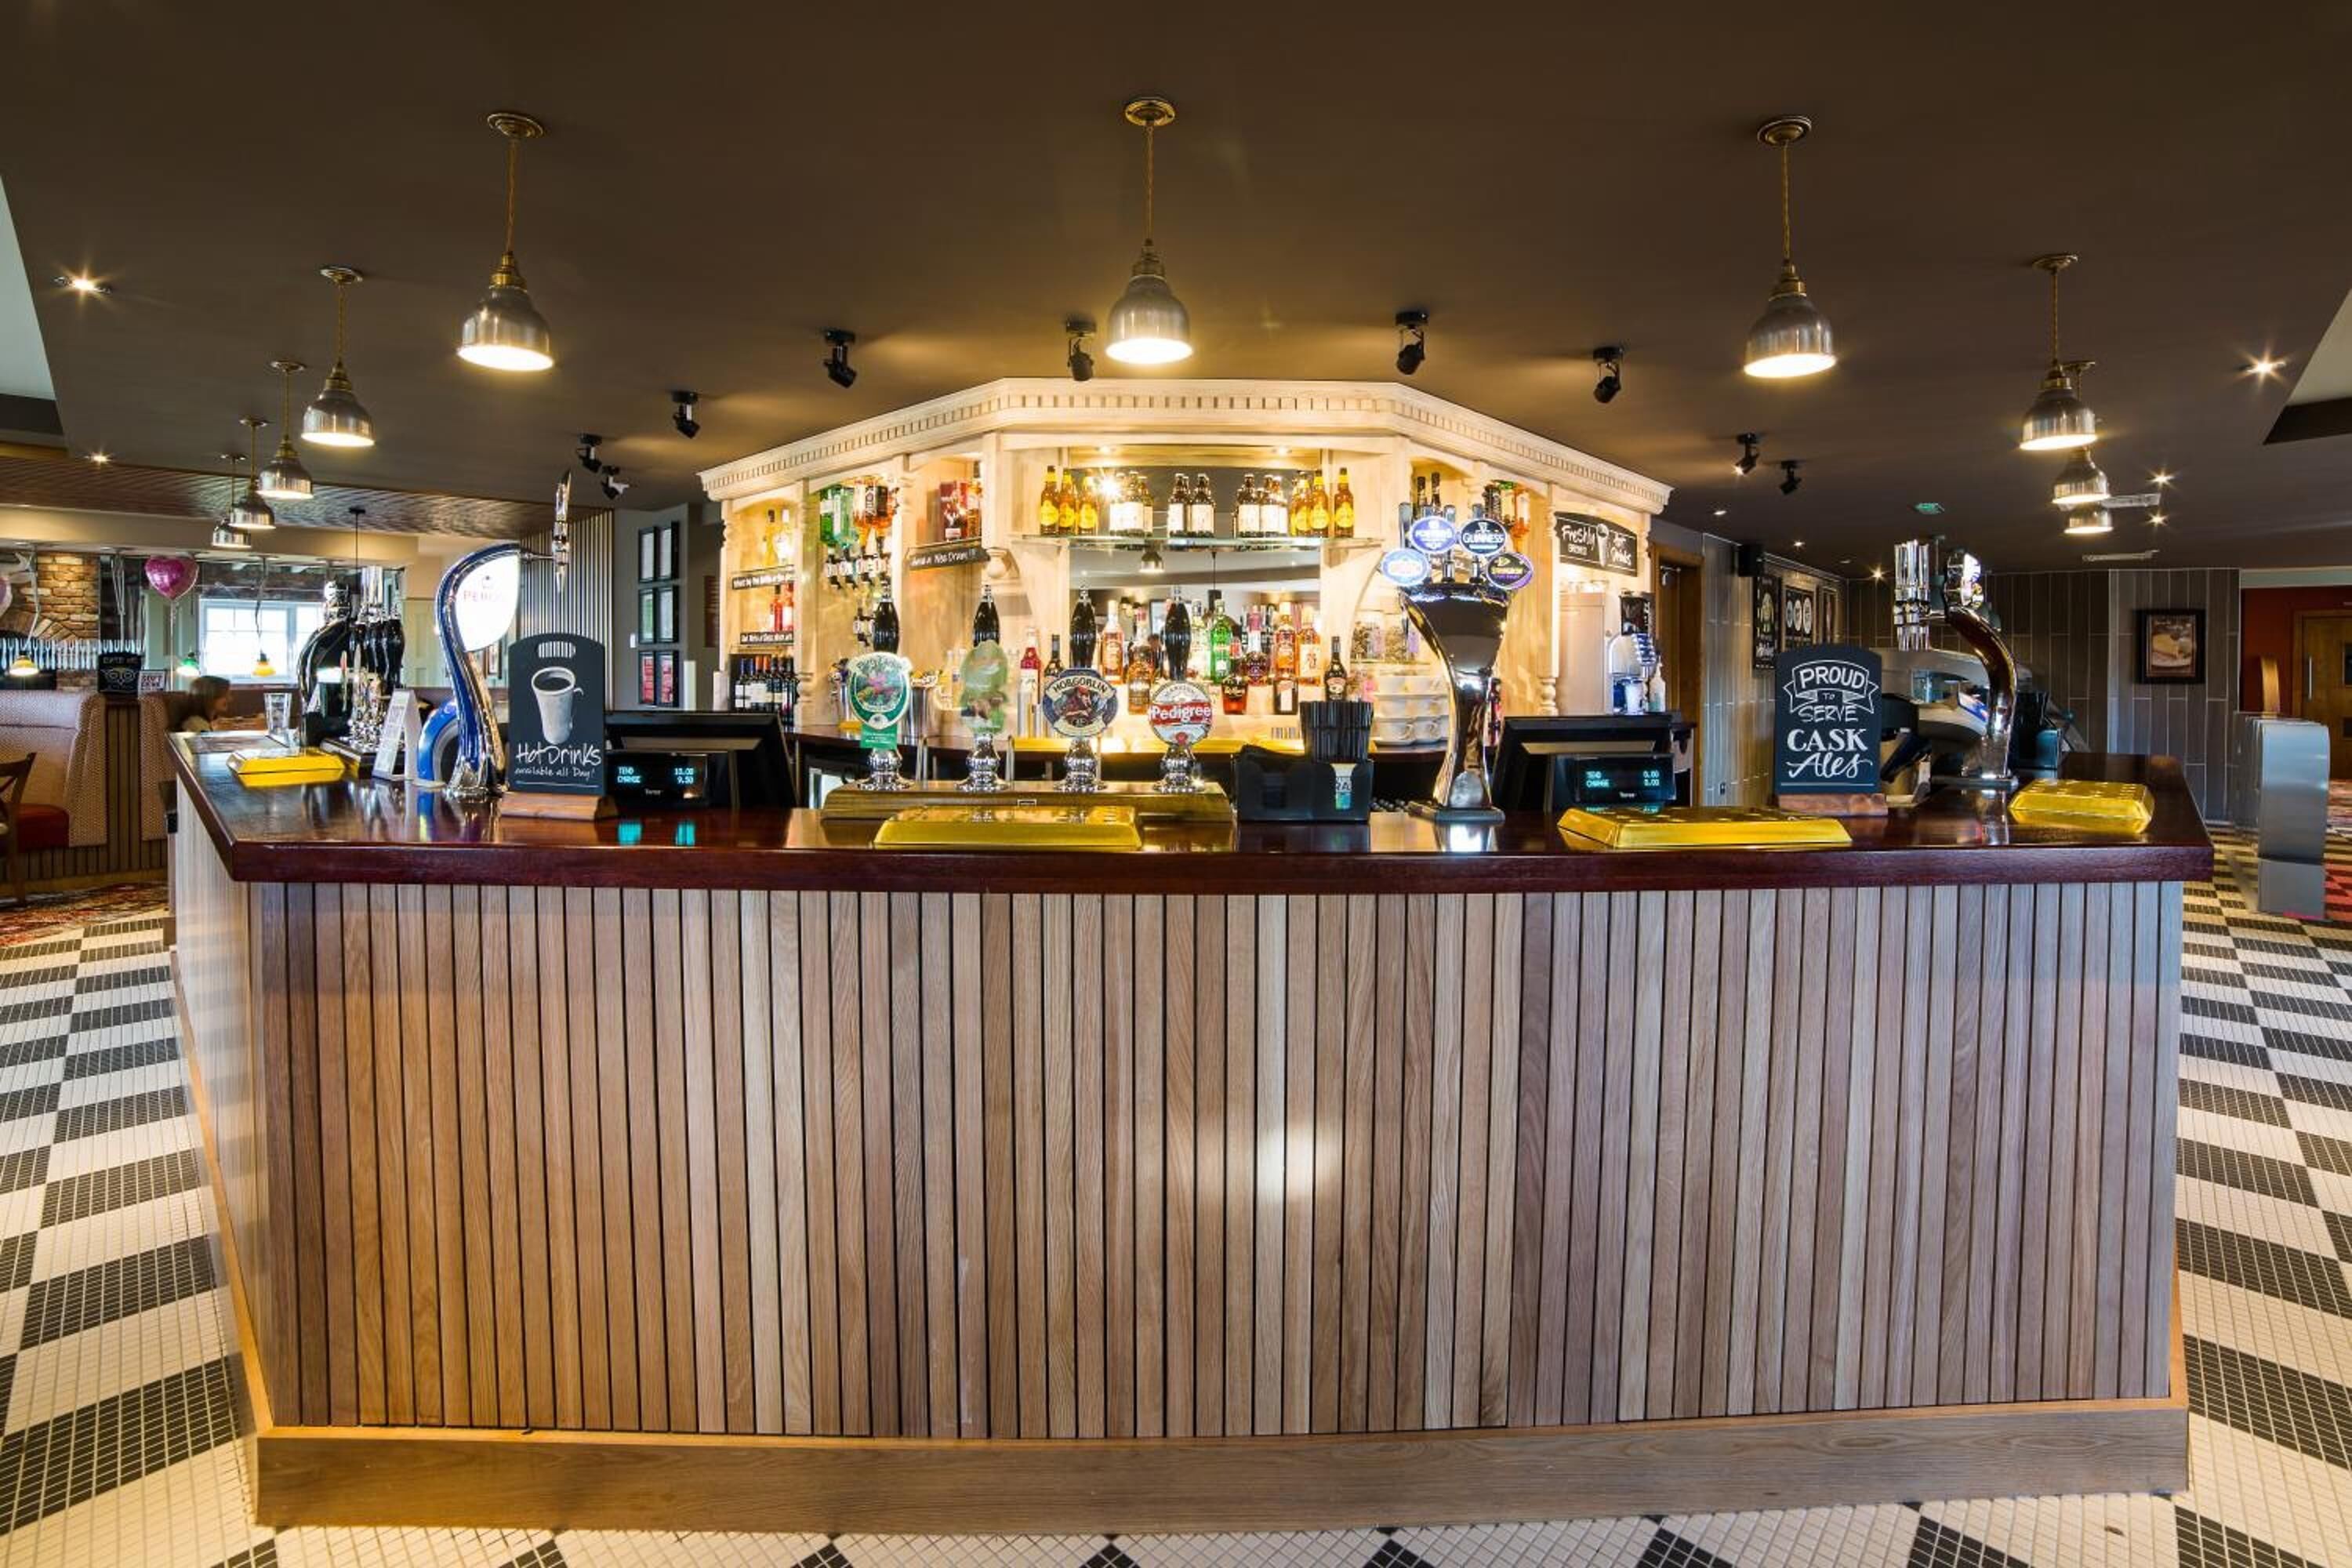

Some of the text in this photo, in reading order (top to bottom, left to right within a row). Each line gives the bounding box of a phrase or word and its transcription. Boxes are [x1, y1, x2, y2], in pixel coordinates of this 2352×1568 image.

[1463, 532, 1504, 544] GUINNESS
[1053, 676, 1109, 693] HOBGOBLIN
[1799, 666, 1865, 689] PROUD
[1149, 703, 1212, 723] Pedigree
[1798, 705, 1859, 722] SERVE
[1787, 728, 1868, 752] CASK
[516, 742, 602, 767] Hot Drinks
[514, 768, 554, 777] available
[556, 768, 568, 777] all
[1786, 751, 1873, 779] Ales
